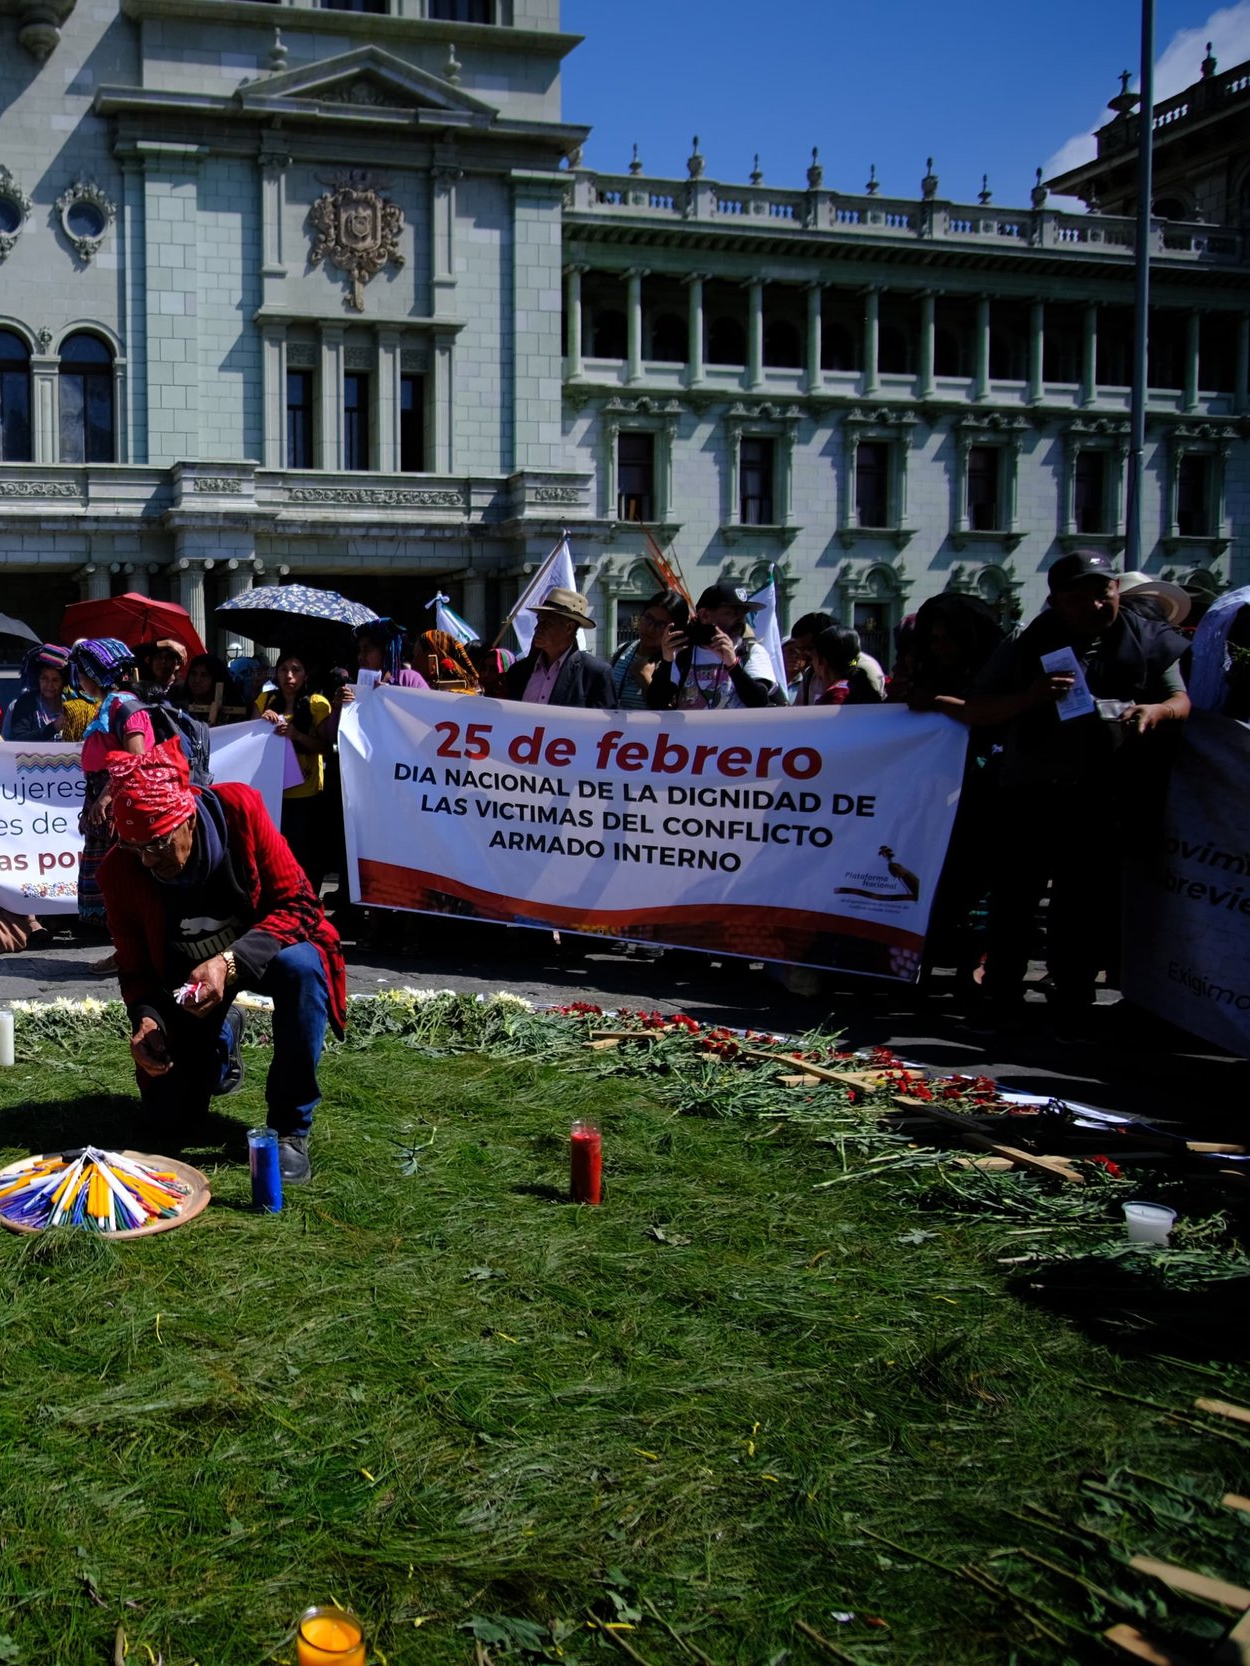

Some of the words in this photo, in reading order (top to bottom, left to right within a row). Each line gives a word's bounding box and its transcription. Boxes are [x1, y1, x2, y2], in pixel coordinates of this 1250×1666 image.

[435, 721, 493, 761] 25
[508, 727, 576, 767] de
[596, 730, 822, 780] febrero
[394, 763, 437, 785] DIA
[445, 768, 570, 797] NACIONAL
[578, 780, 614, 801] DE
[623, 783, 658, 804] LA
[667, 786, 821, 813] DIGNIDAD
[831, 793, 876, 817] DE
[32, 811, 67, 834] de
[421, 794, 468, 816] LAS
[475, 799, 594, 828] VICTIMAS
[602, 811, 654, 834] DEL
[662, 816, 833, 848] CONFLICTO
[488, 830, 605, 859] ARMADO
[614, 842, 741, 872] INTERNO
